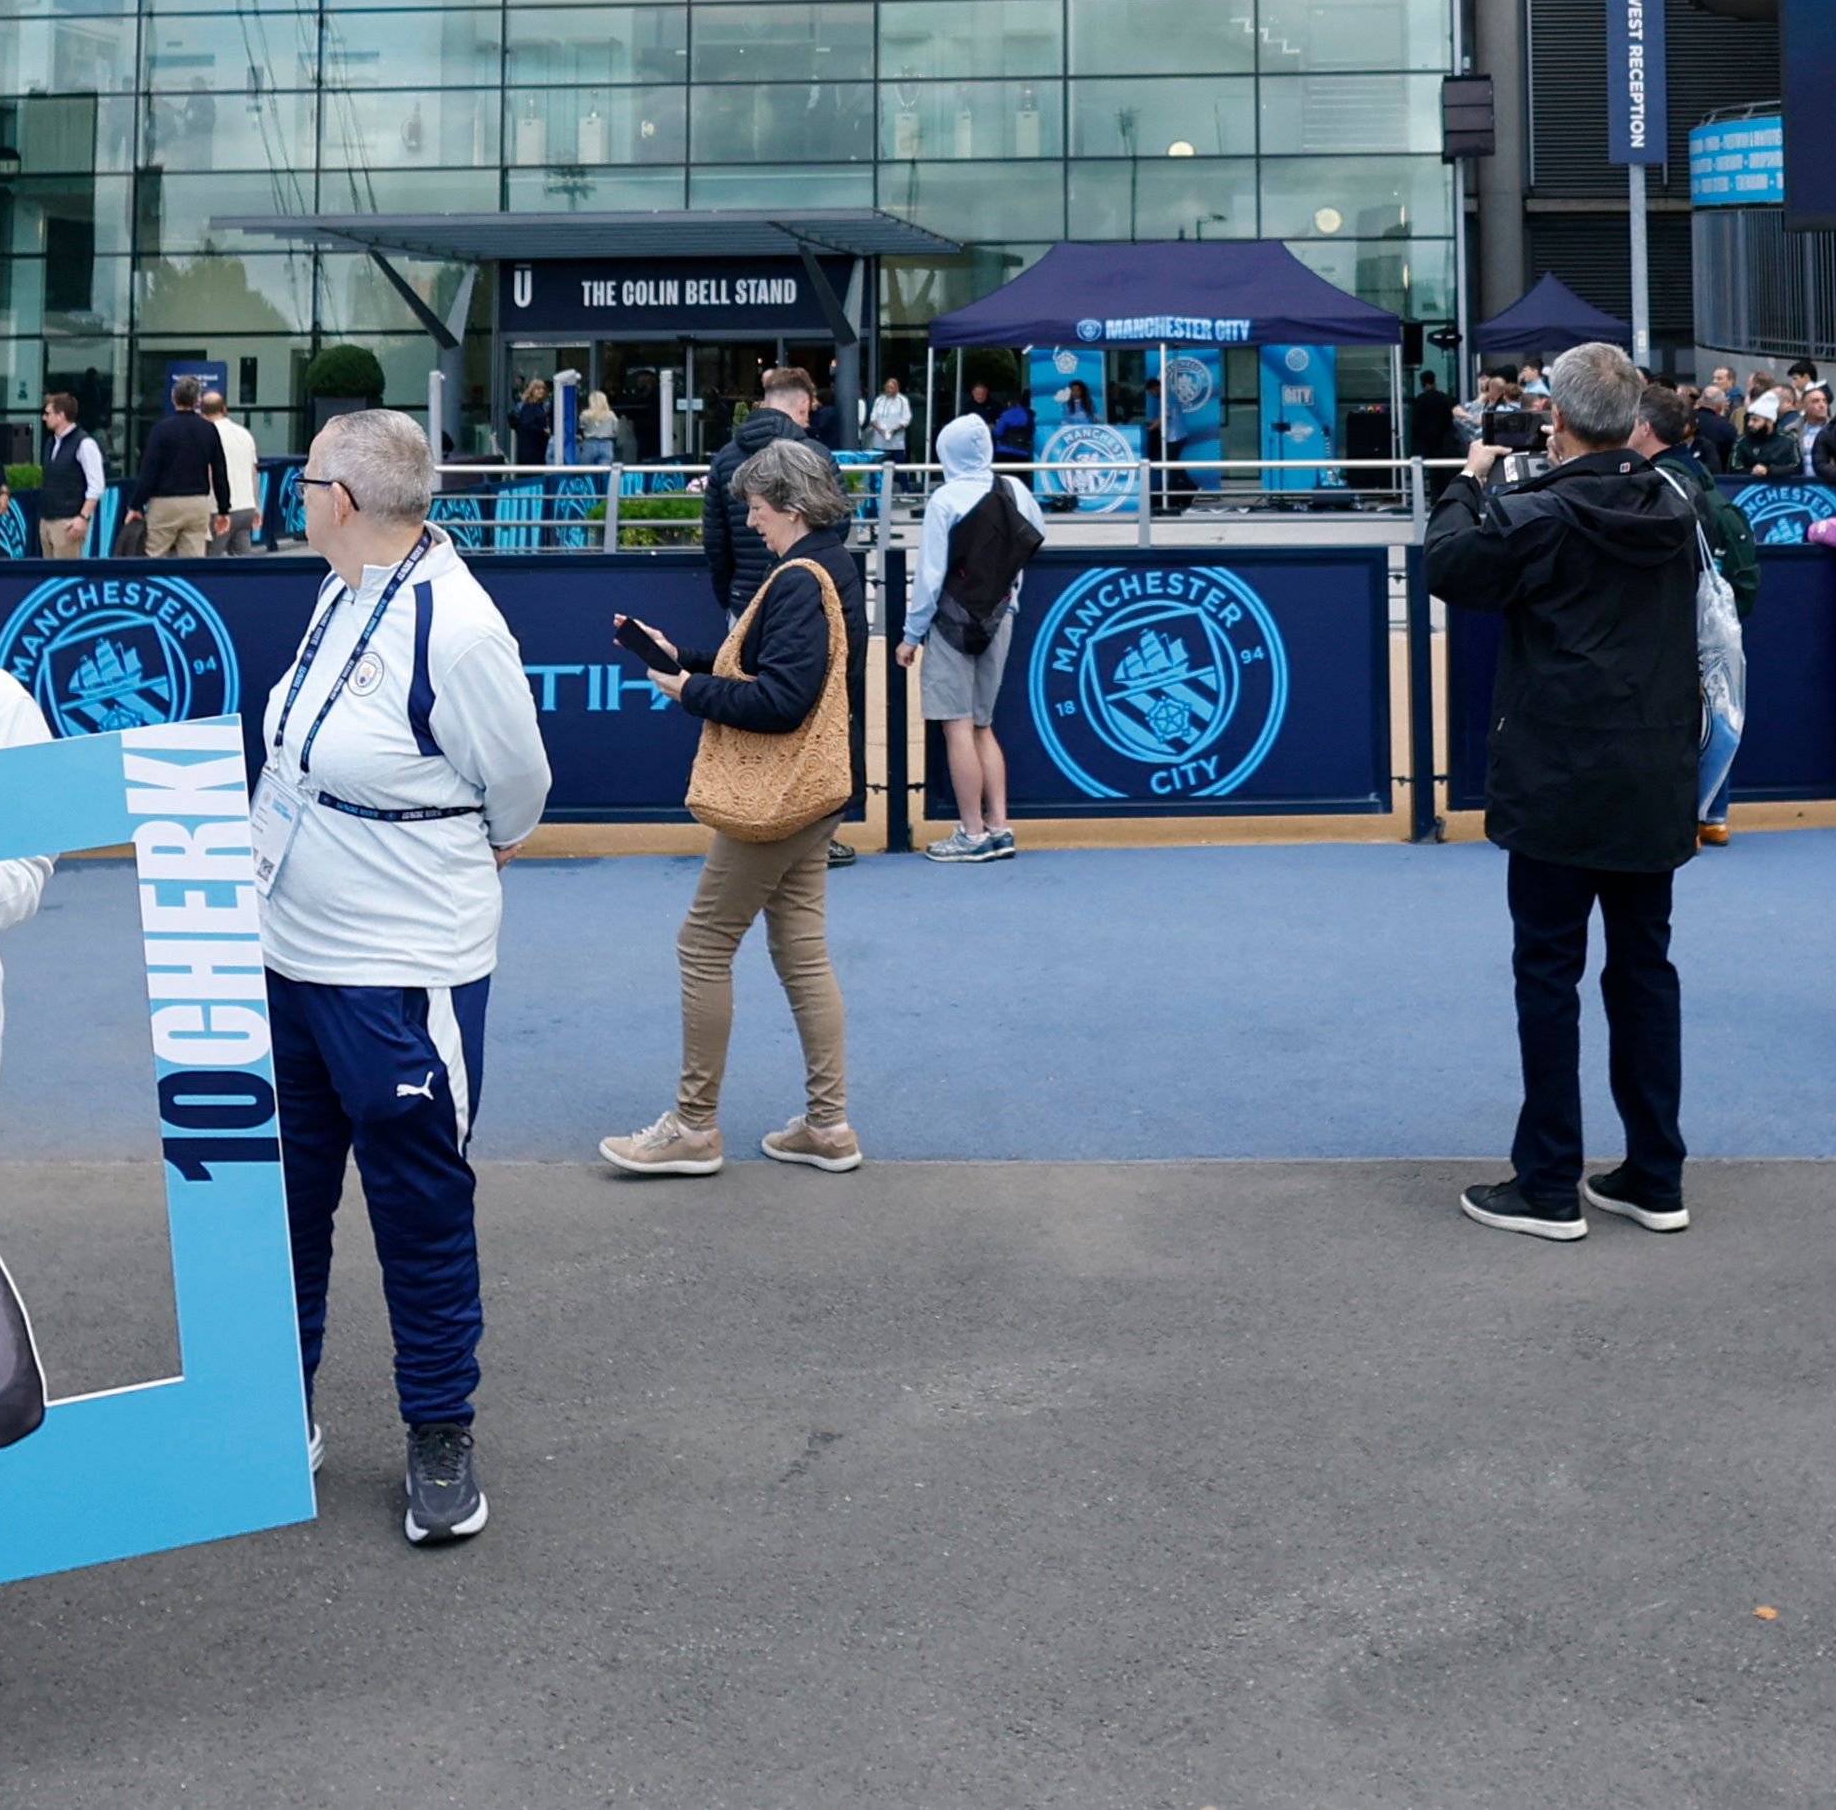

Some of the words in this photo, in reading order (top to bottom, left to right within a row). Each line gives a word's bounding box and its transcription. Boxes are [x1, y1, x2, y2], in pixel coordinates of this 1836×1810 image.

[1628, 45, 1644, 148] RECEPTION
[581, 280, 617, 308] THE
[621, 279, 681, 307] COLIN
[684, 278, 731, 306] BELL
[734, 277, 797, 305] STAND
[1105, 316, 1212, 340] MANCHESTER
[1215, 319, 1251, 341] CITY
[10, 578, 199, 684] MANCHESTER
[193, 656, 218, 674] 94
[1052, 571, 1244, 673] MANCHESTER
[1055, 699, 1076, 718] 18
[1241, 646, 1265, 664] 94
[1149, 754, 1219, 796] CITY
[121, 724, 271, 1067] CHERKI
[157, 1070, 280, 1184] 10
